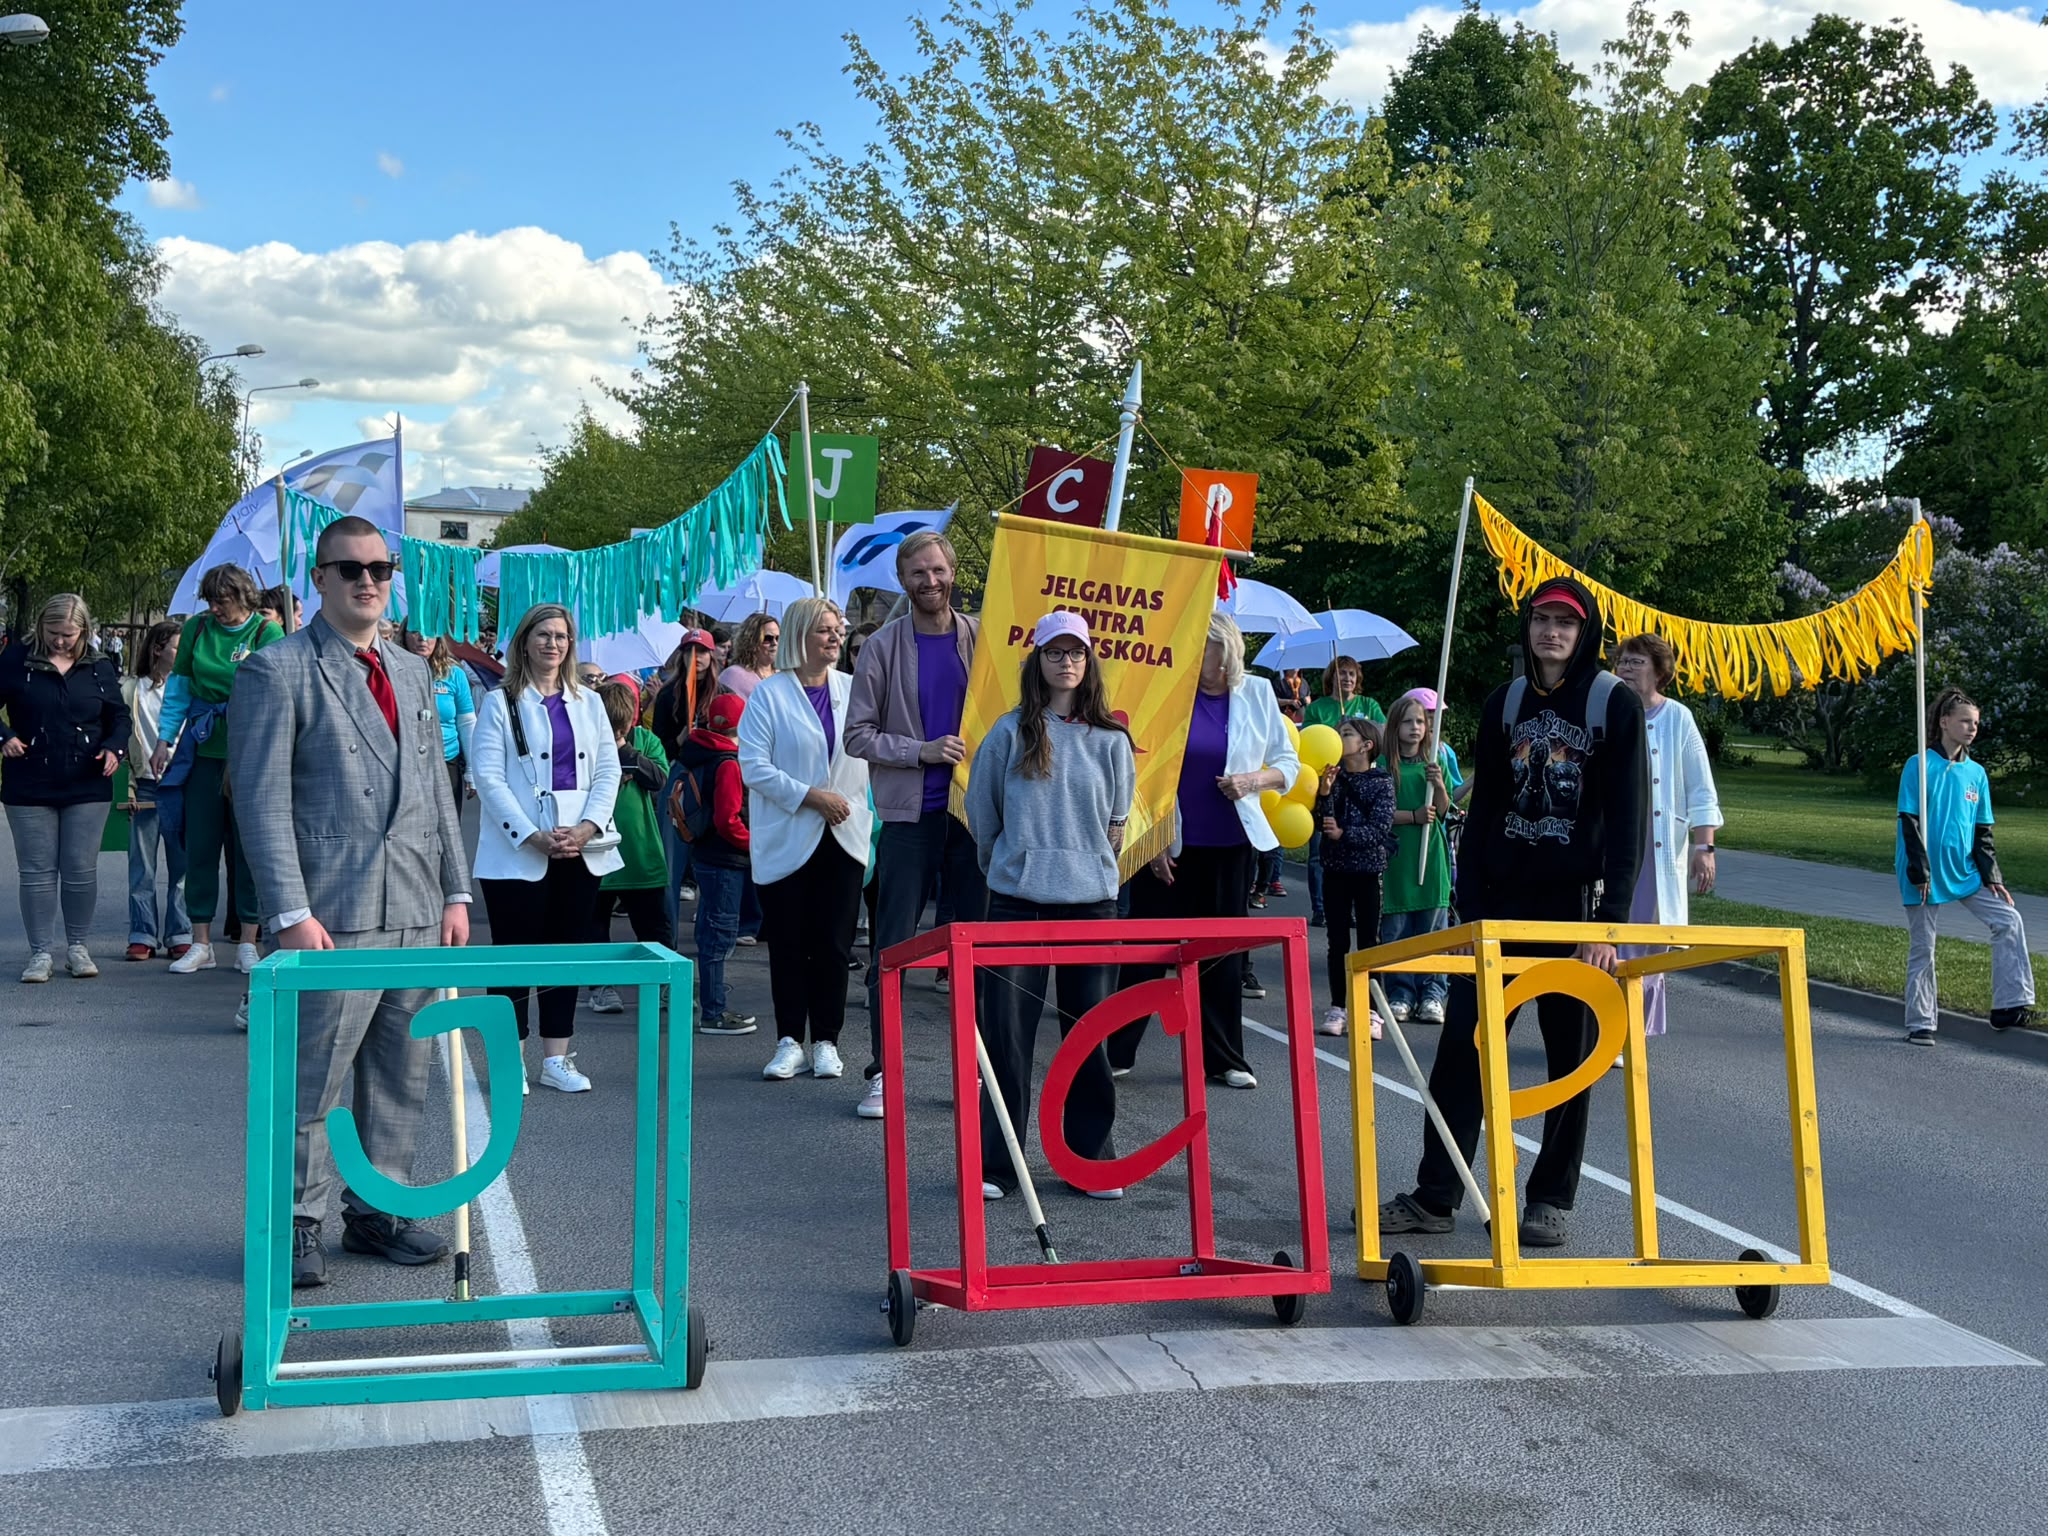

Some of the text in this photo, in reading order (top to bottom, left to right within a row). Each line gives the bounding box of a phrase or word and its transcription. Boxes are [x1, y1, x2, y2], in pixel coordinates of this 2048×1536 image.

[812, 447, 853, 499] J
[1046, 468, 1084, 514] C
[1041, 574, 1165, 611] JELGAVAS
[1007, 625, 1174, 669] PATSKOLA
[325, 994, 524, 1219] J
[1038, 977, 1207, 1192] C
